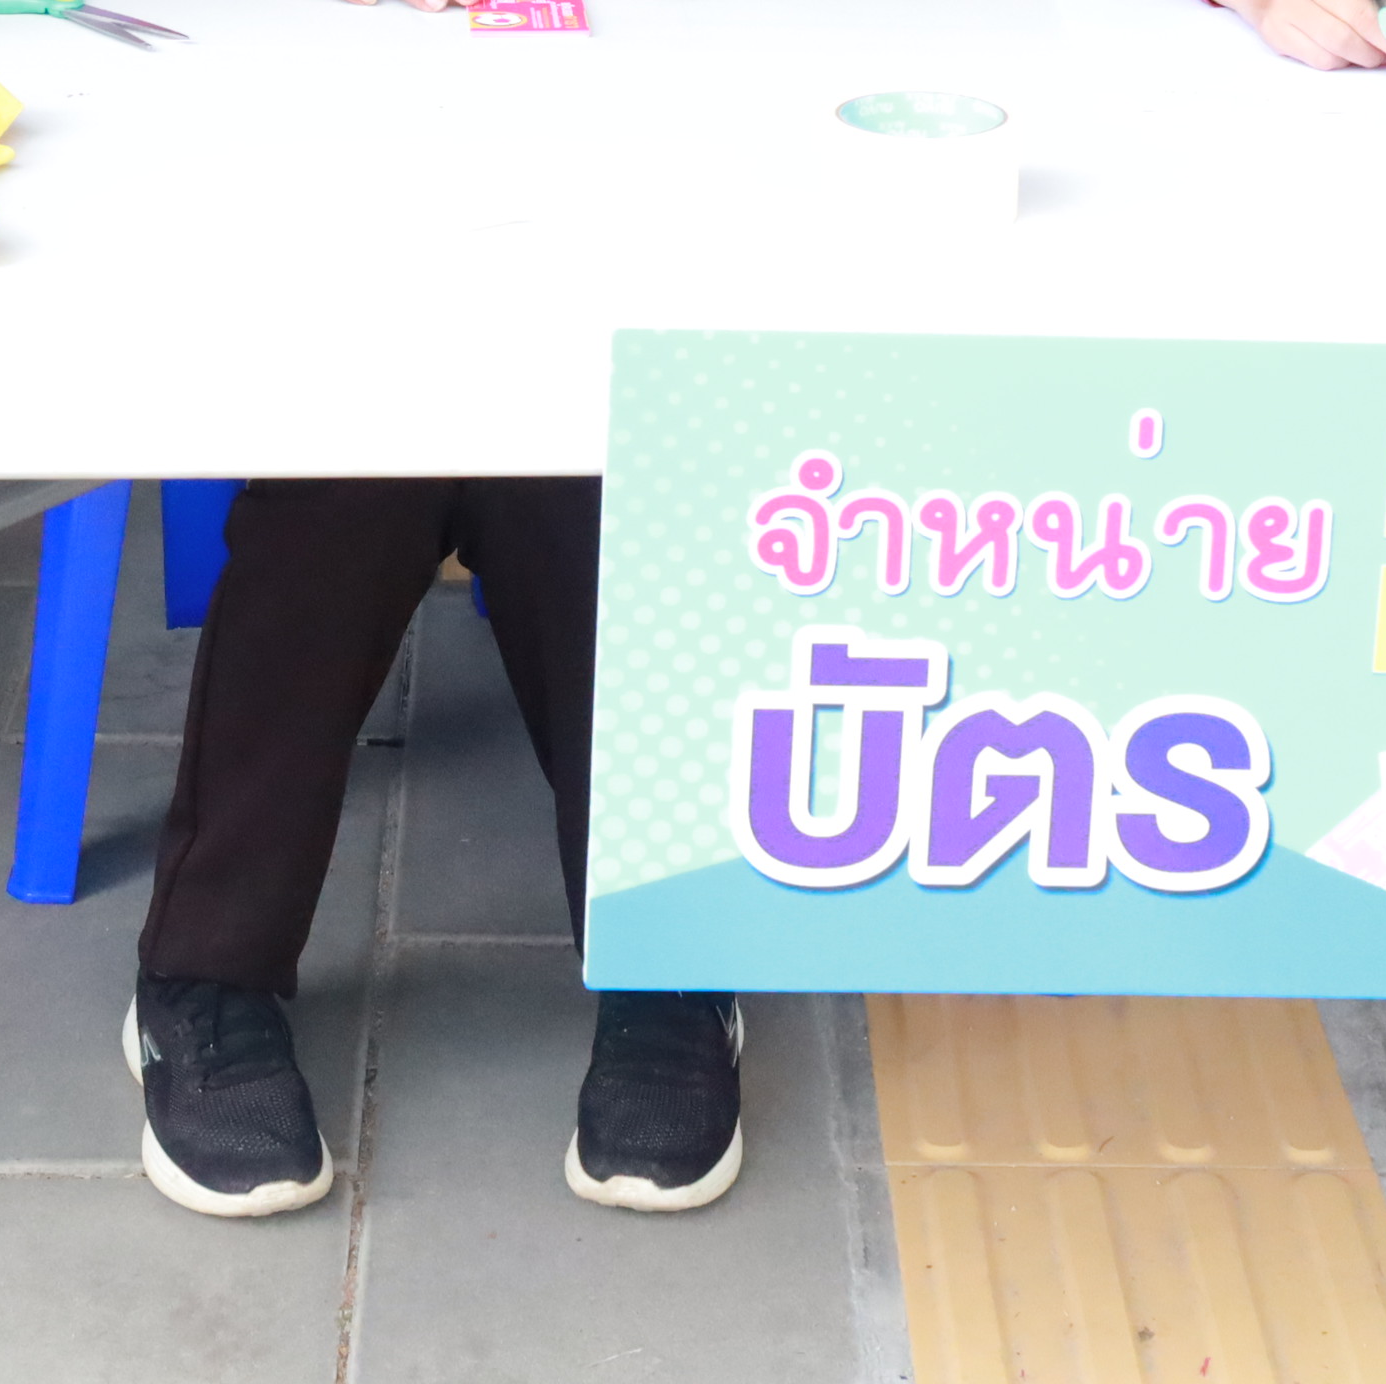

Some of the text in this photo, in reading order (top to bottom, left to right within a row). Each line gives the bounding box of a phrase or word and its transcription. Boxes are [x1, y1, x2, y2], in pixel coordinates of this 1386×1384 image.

[748, 408, 1333, 603] จำหน่าย
[748, 642, 1254, 874] บัตร
